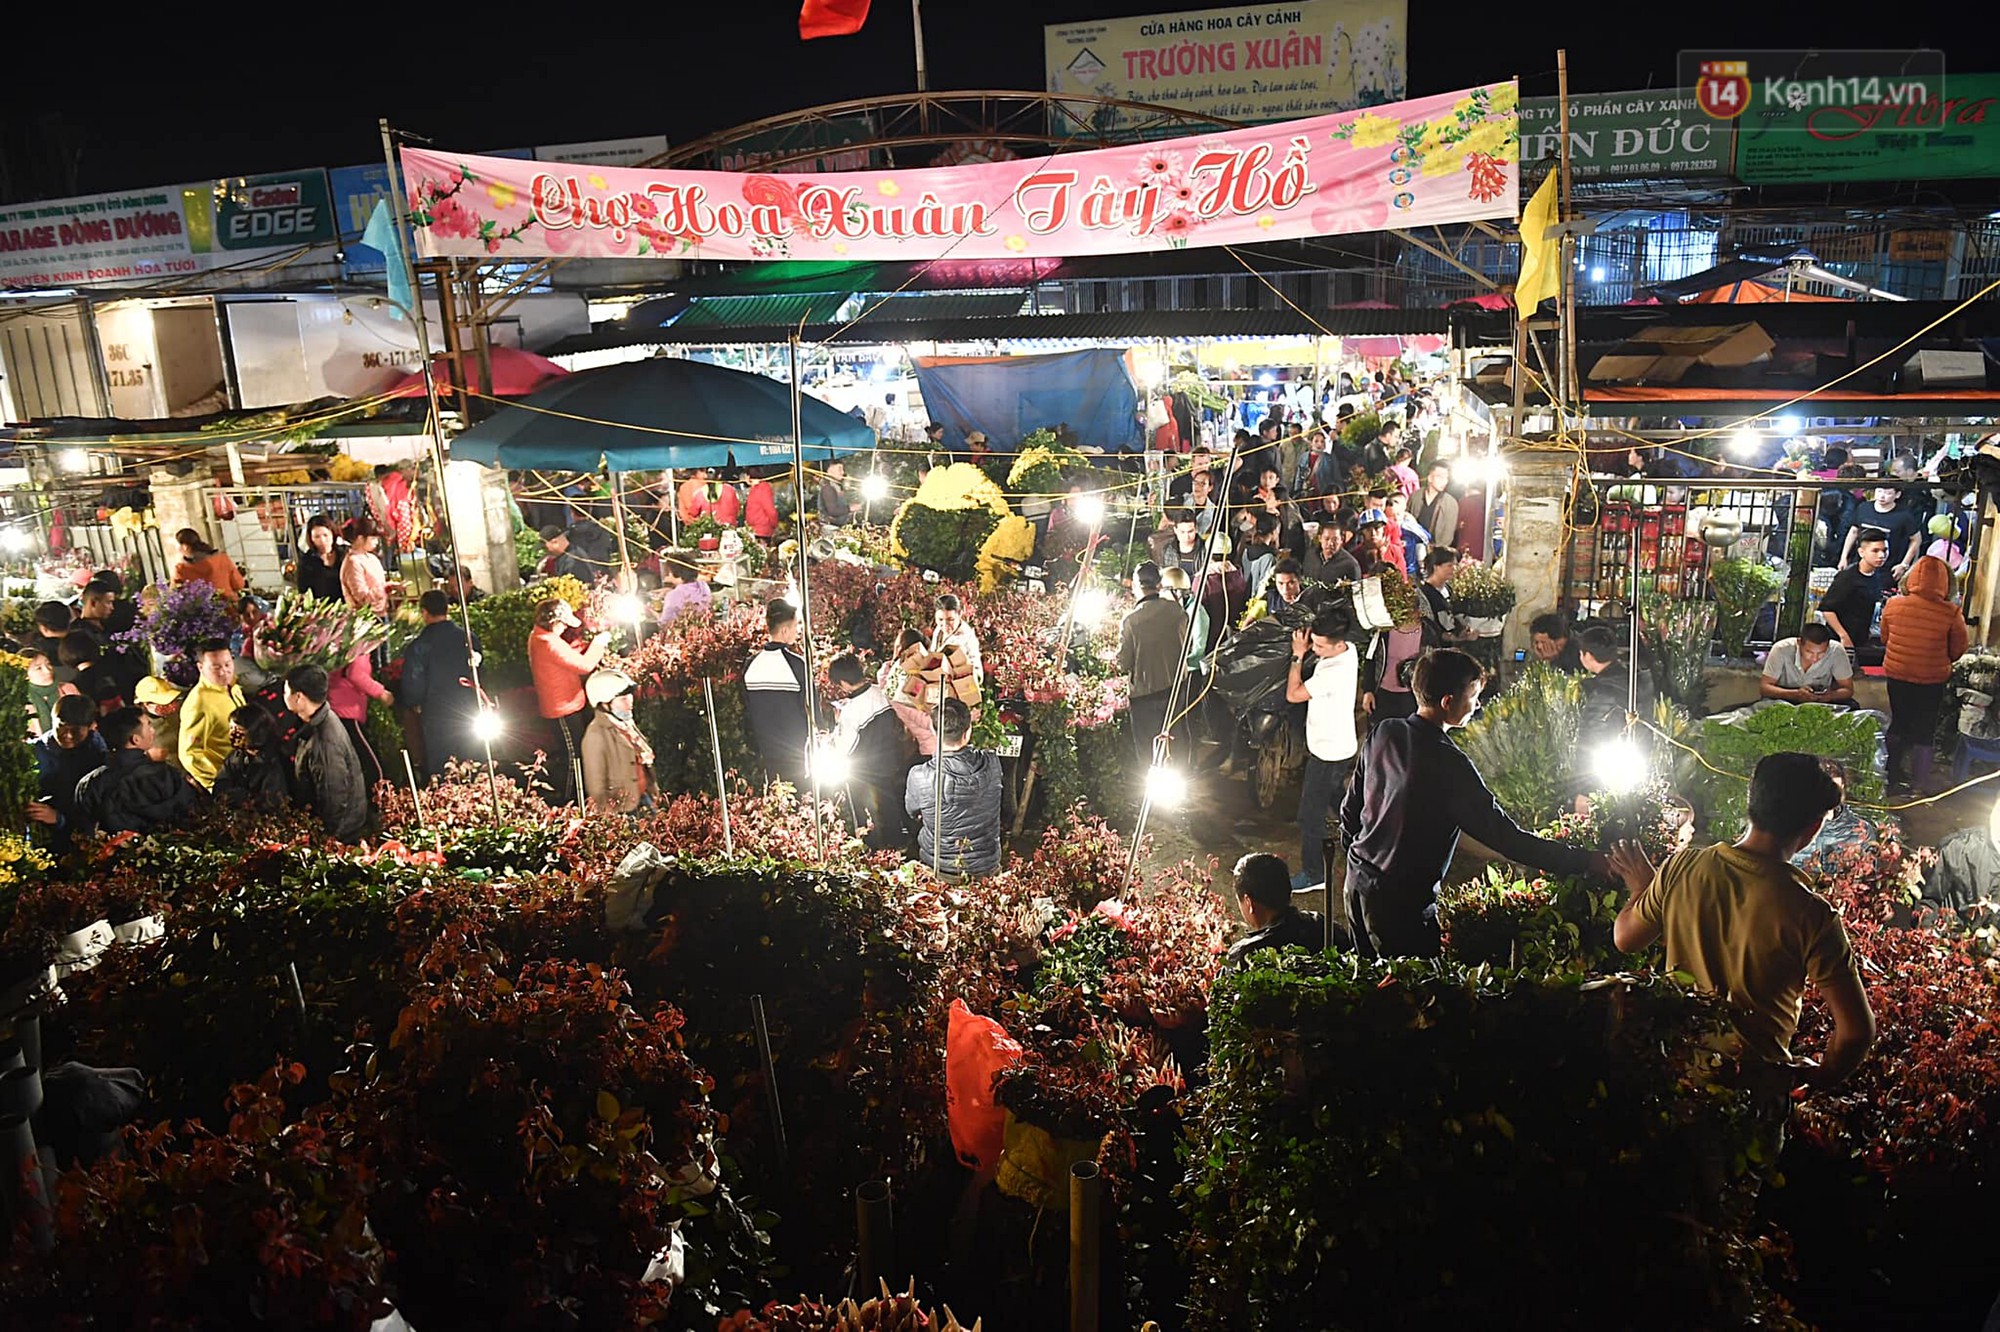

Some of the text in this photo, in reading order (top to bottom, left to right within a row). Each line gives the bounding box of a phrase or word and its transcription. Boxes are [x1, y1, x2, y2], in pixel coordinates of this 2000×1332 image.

[1140, 9, 1301, 36] CỬA HÀNG HOA CÂY CẢNH
[1122, 30, 1322, 81] TRƯỜNG XUÂN
[1519, 109, 1534, 120] NG
[1539, 107, 1556, 118] TY
[1626, 99, 1655, 114] CÂY
[1659, 98, 1697, 112] XANH
[1519, 117, 1711, 161] IẾN ĐỨC
[531, 136, 1316, 243] Chợ Hoa Xuân Tây Hồ
[229, 206, 317, 240] EDGE
[0, 225, 58, 252] ARAGE
[53, 269, 84, 282] KINH
[88, 266, 131, 280] DOANH
[135, 263, 162, 275] HOA
[165, 259, 196, 272] TƯƠI
[108, 369, 143, 387] 71.35
